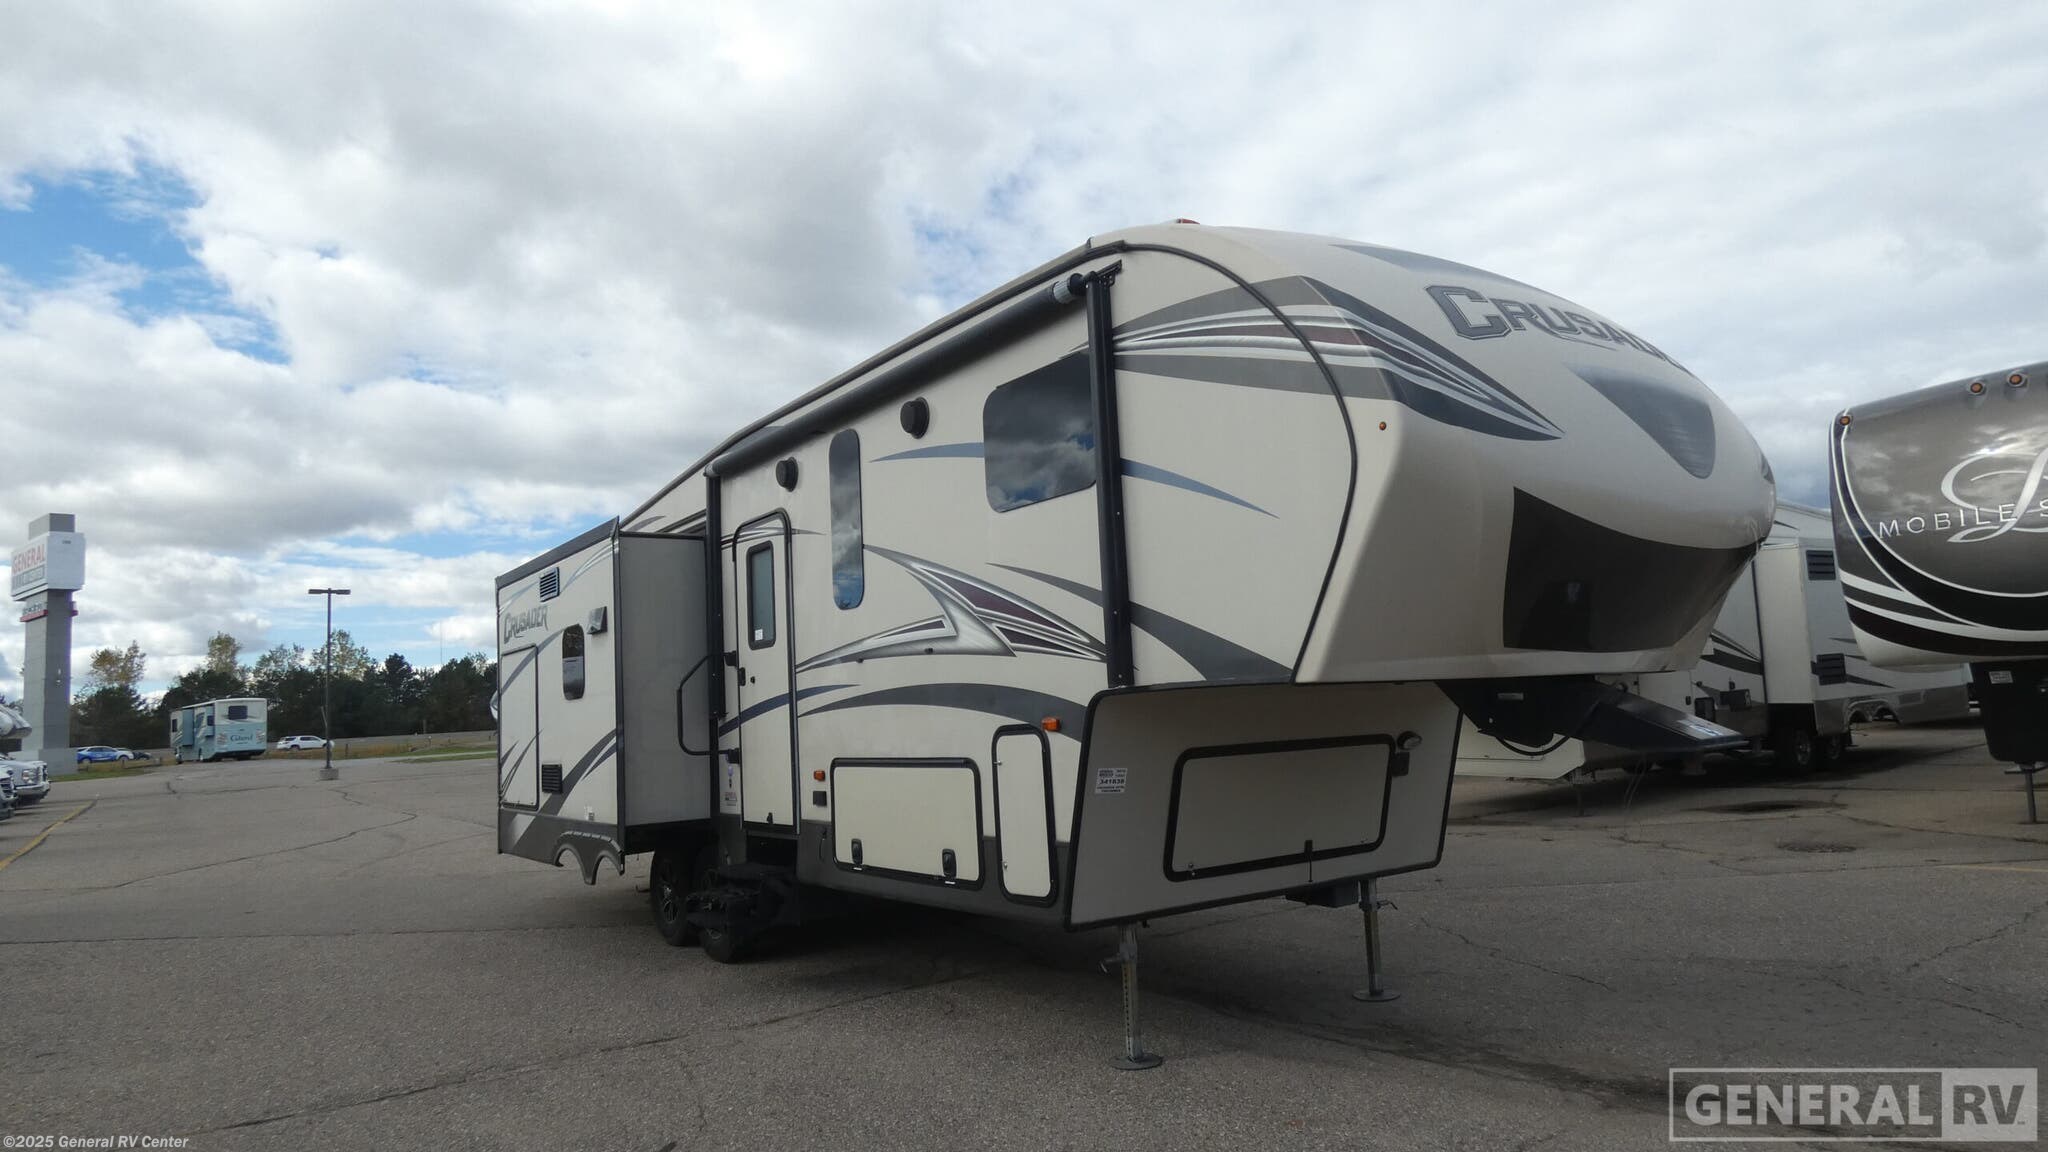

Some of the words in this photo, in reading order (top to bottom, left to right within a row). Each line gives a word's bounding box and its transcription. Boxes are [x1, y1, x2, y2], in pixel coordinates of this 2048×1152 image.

[1425, 284, 1694, 375] CRUSAD
[1878, 503, 2018, 539] MOBILE
[503, 605, 549, 645] CRUSADER
